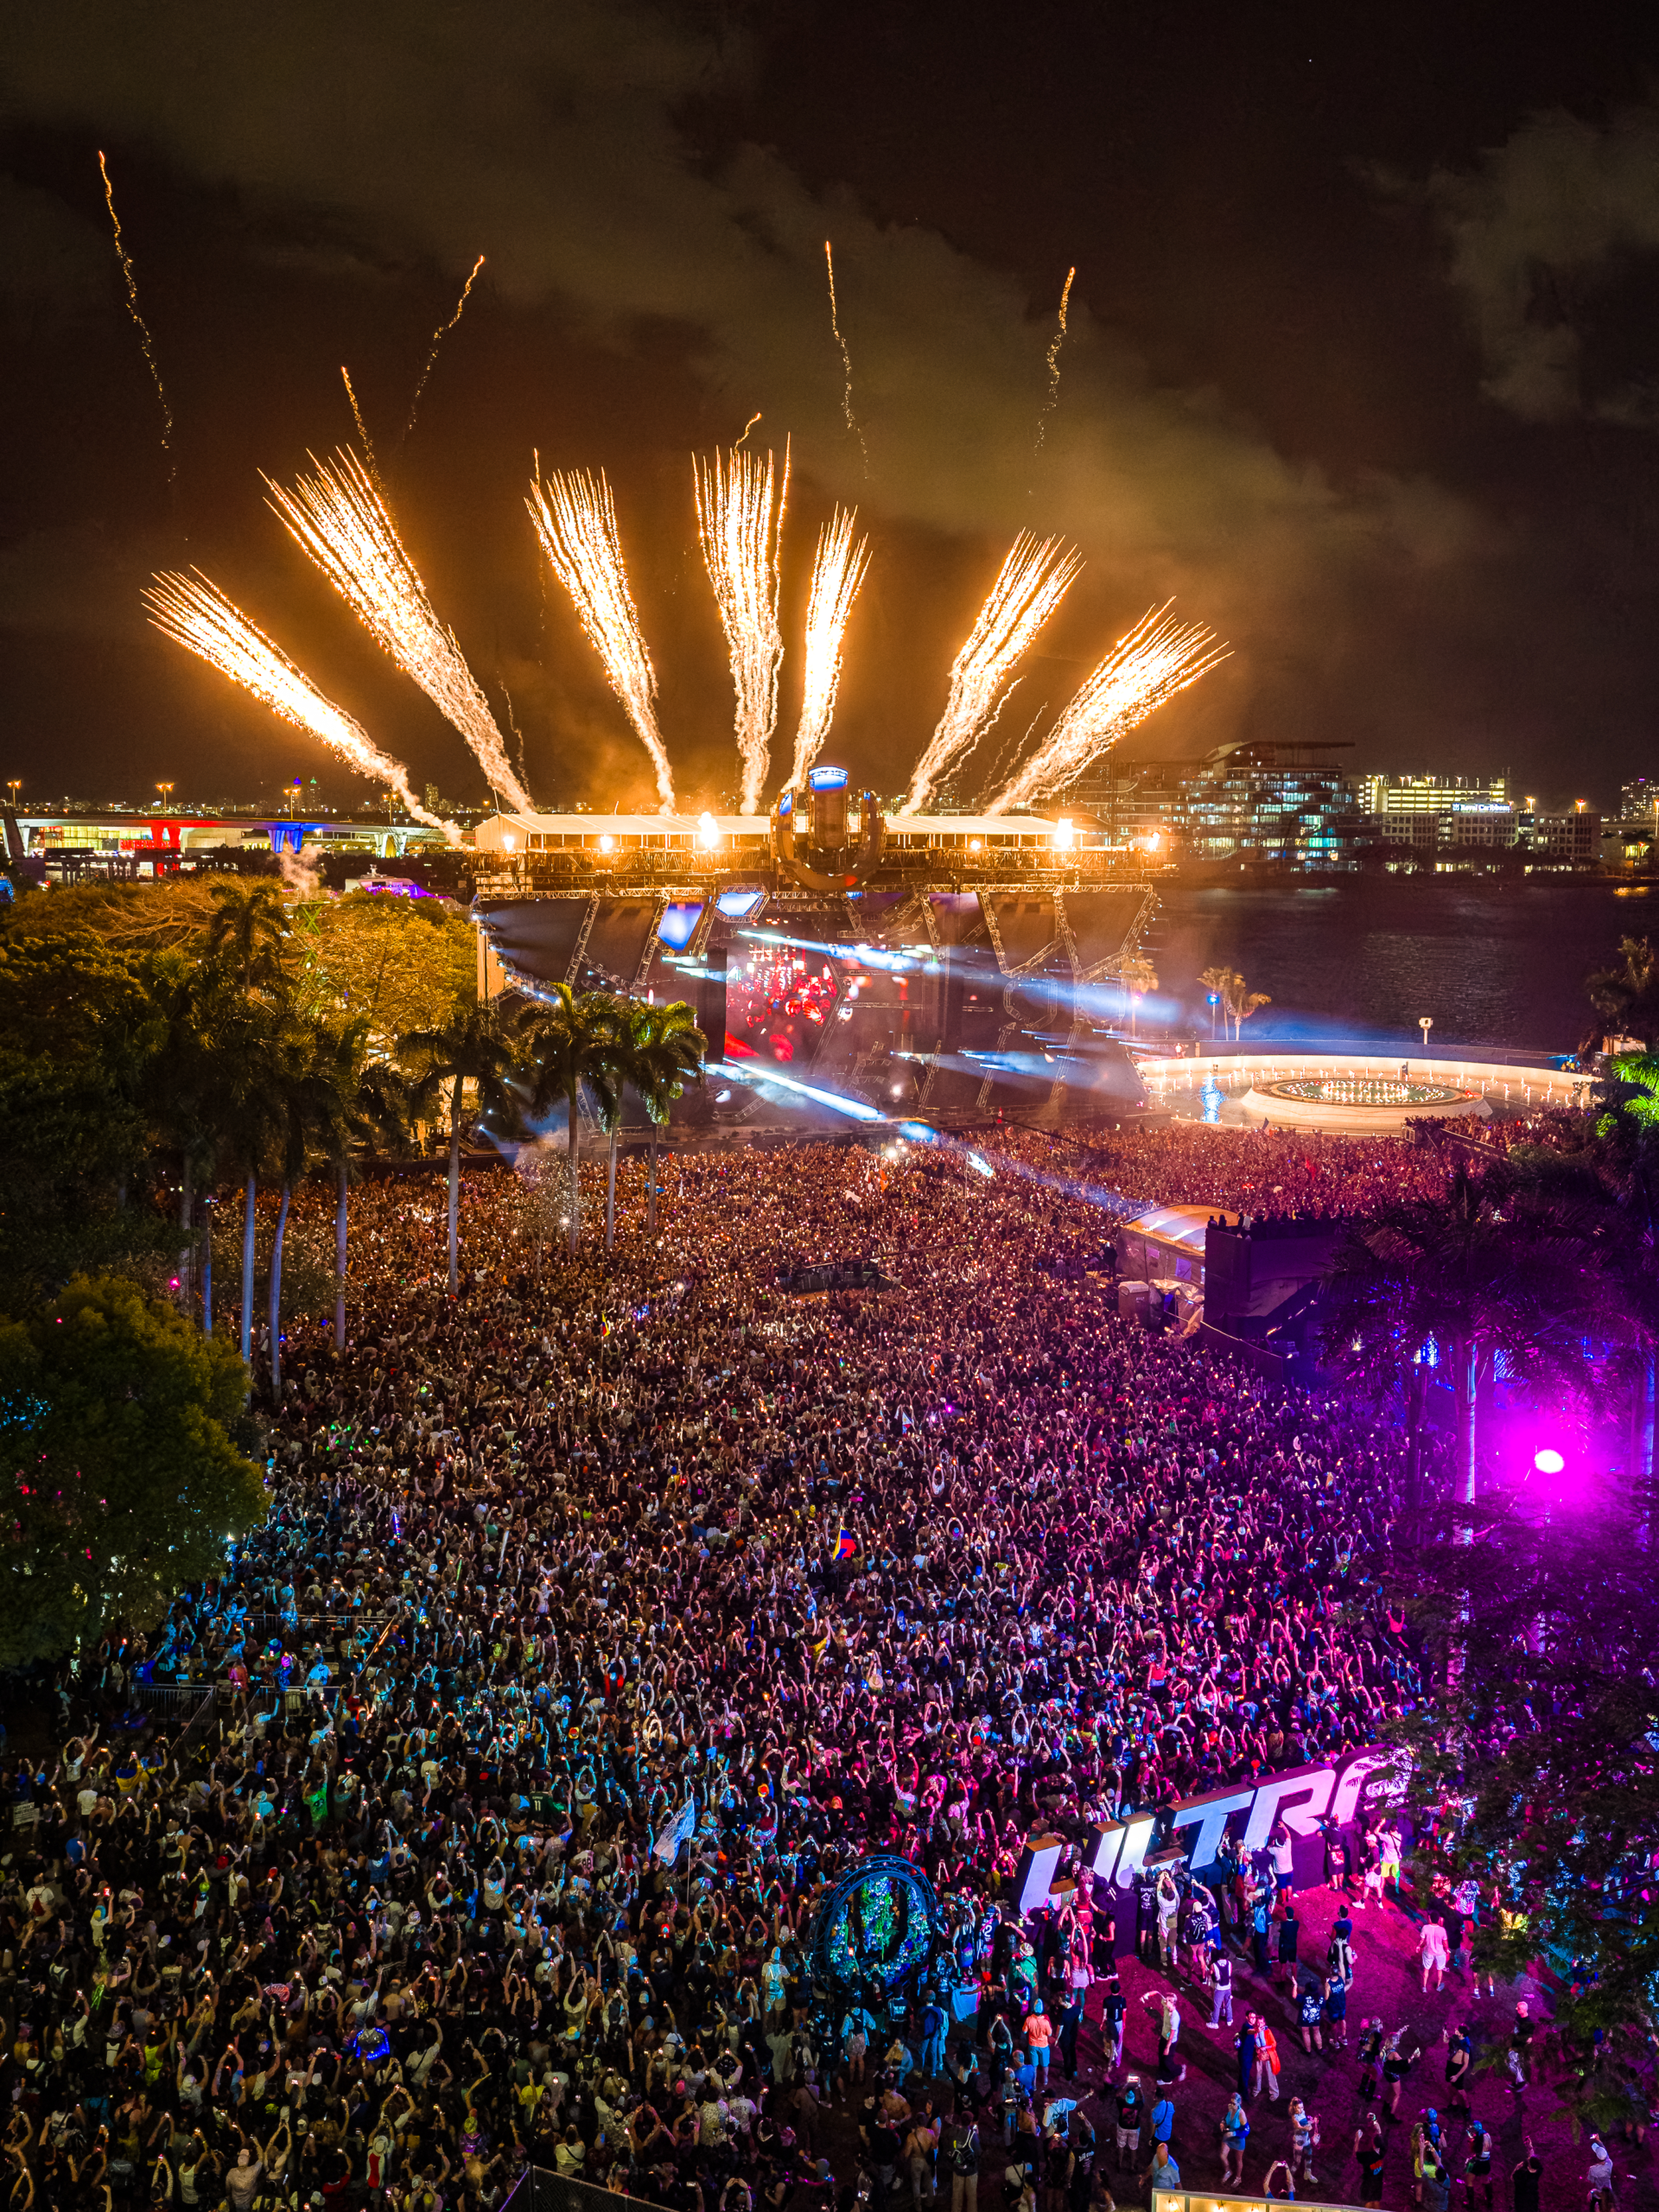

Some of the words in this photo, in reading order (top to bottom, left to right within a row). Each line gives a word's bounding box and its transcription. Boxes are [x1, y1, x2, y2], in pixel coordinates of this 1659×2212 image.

[1460, 804, 1478, 813] Royal
[1478, 804, 1510, 812] Caribbean
[1020, 1747, 1414, 1916] ULTRA
